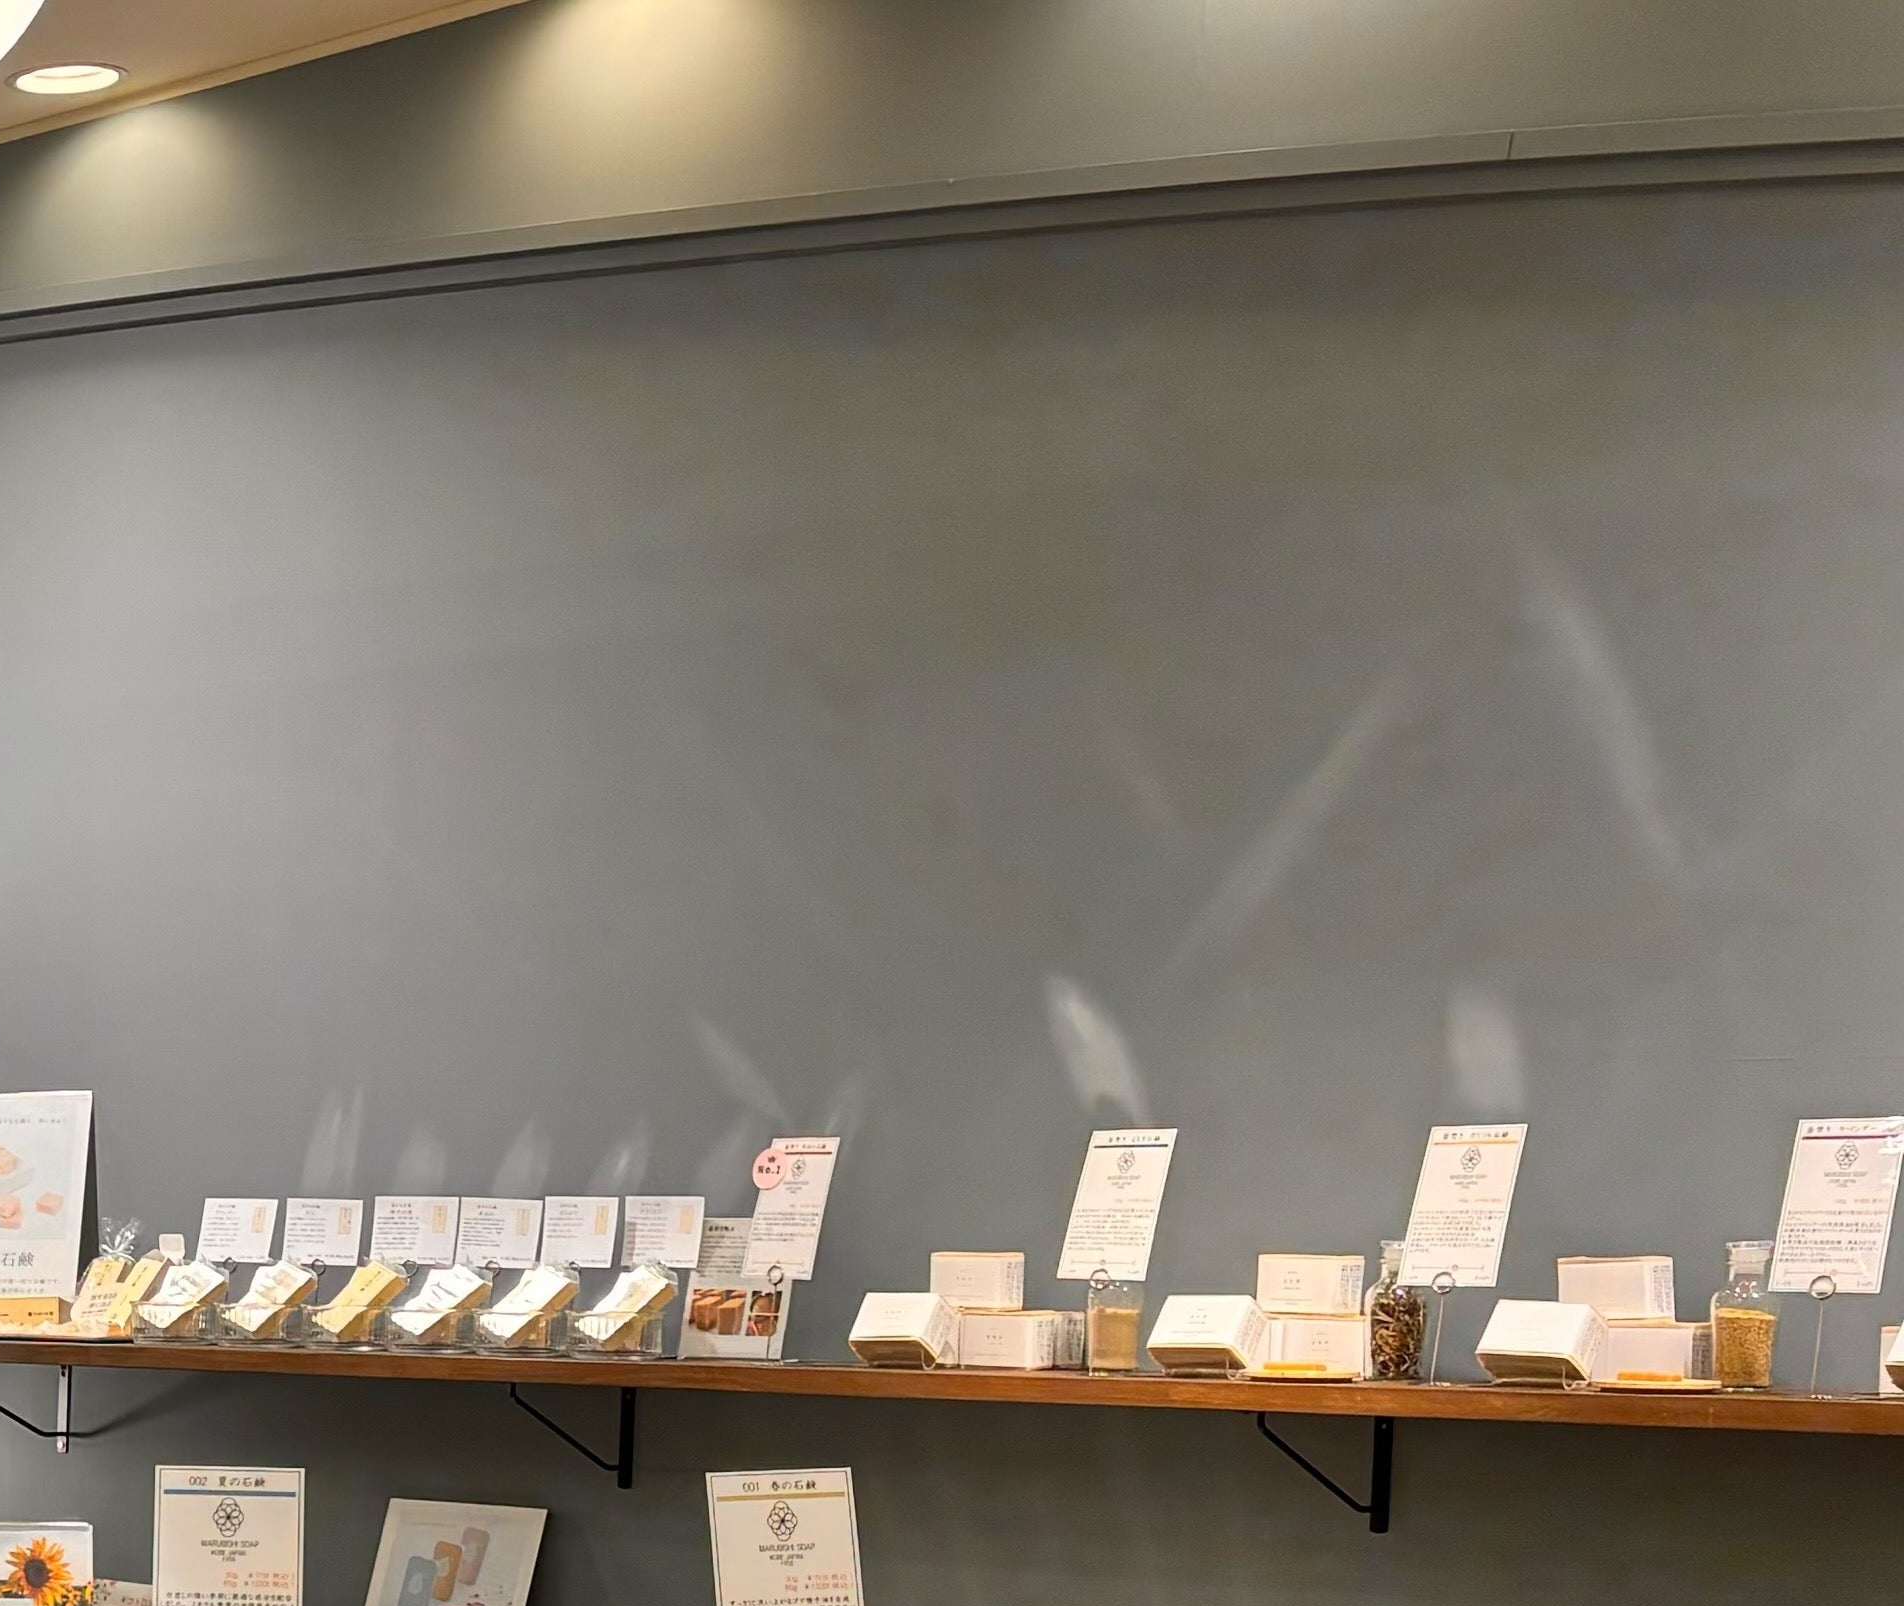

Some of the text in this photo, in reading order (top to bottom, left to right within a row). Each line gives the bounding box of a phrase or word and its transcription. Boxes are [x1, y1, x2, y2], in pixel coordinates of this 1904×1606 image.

[189, 1476, 265, 1488] 002 夏の石鹸
[743, 1479, 817, 1492] 001 春の石鹸
